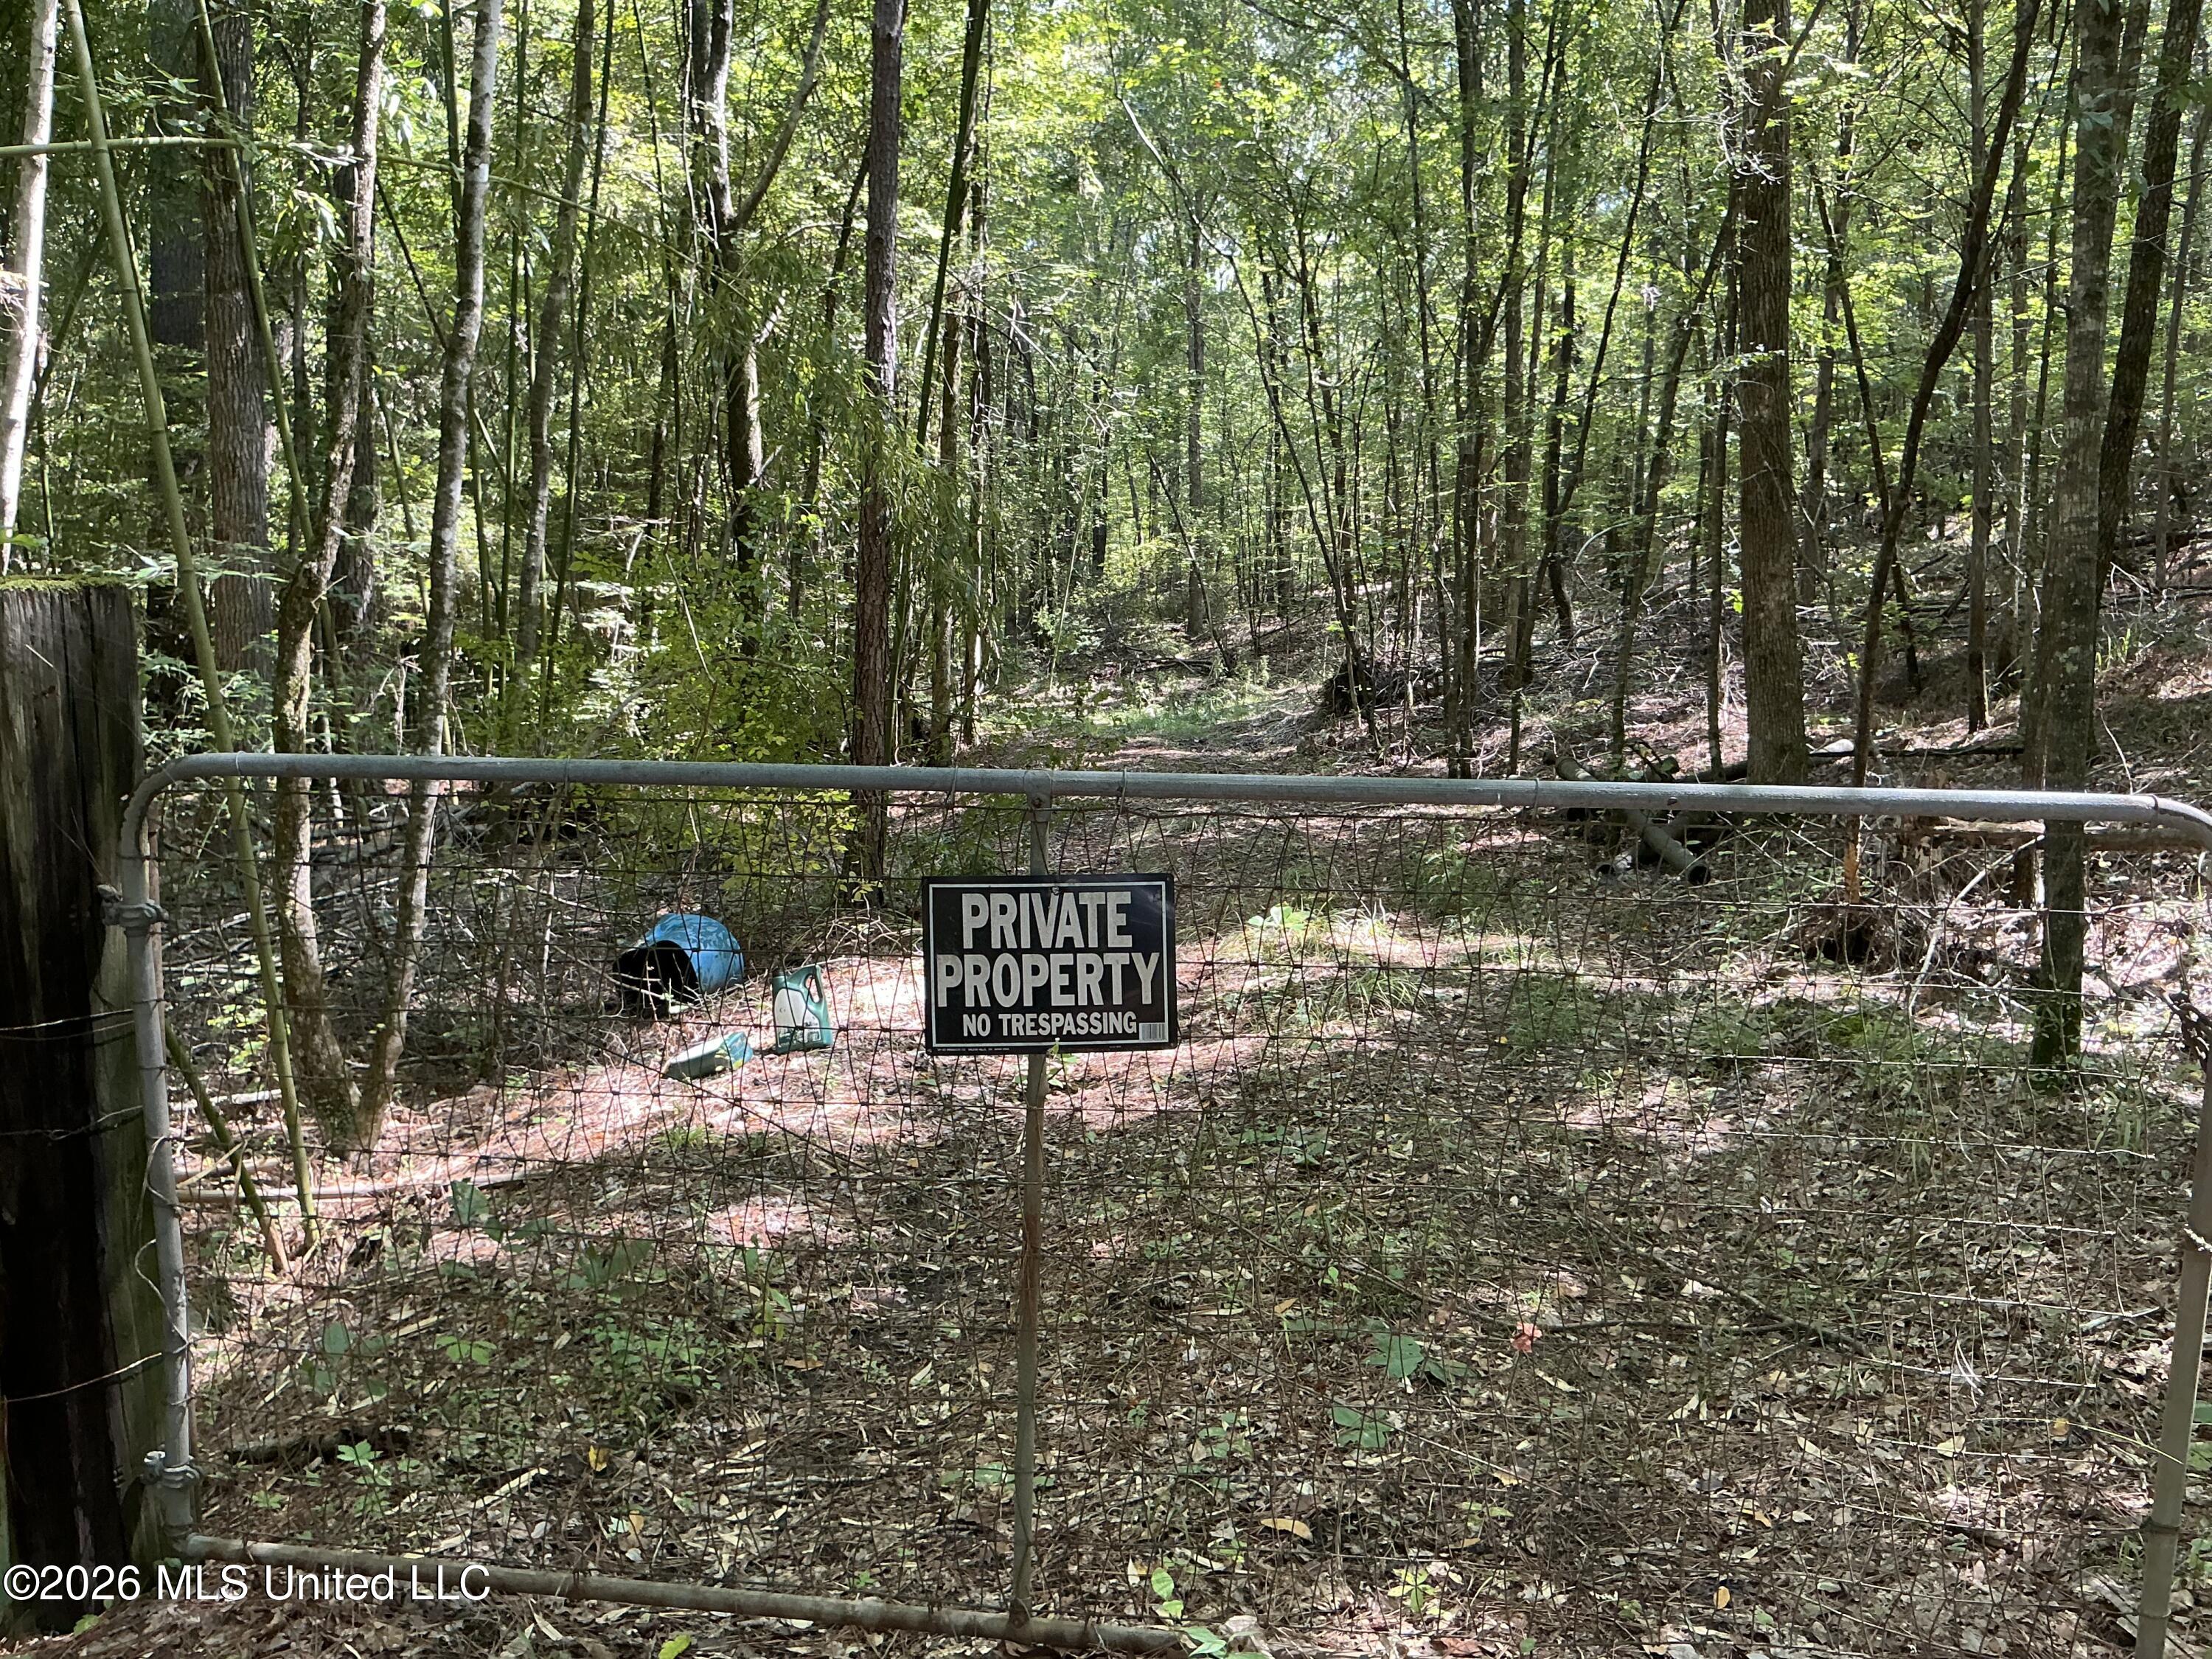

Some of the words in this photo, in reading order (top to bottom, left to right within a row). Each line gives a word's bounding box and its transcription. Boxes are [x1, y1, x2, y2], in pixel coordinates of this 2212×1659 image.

[961, 891, 1133, 949] PRIVATE
[936, 952, 1160, 1008] PROPERTY
[962, 1014, 991, 1037] NO
[998, 1011, 1137, 1036] TRESPASSING
